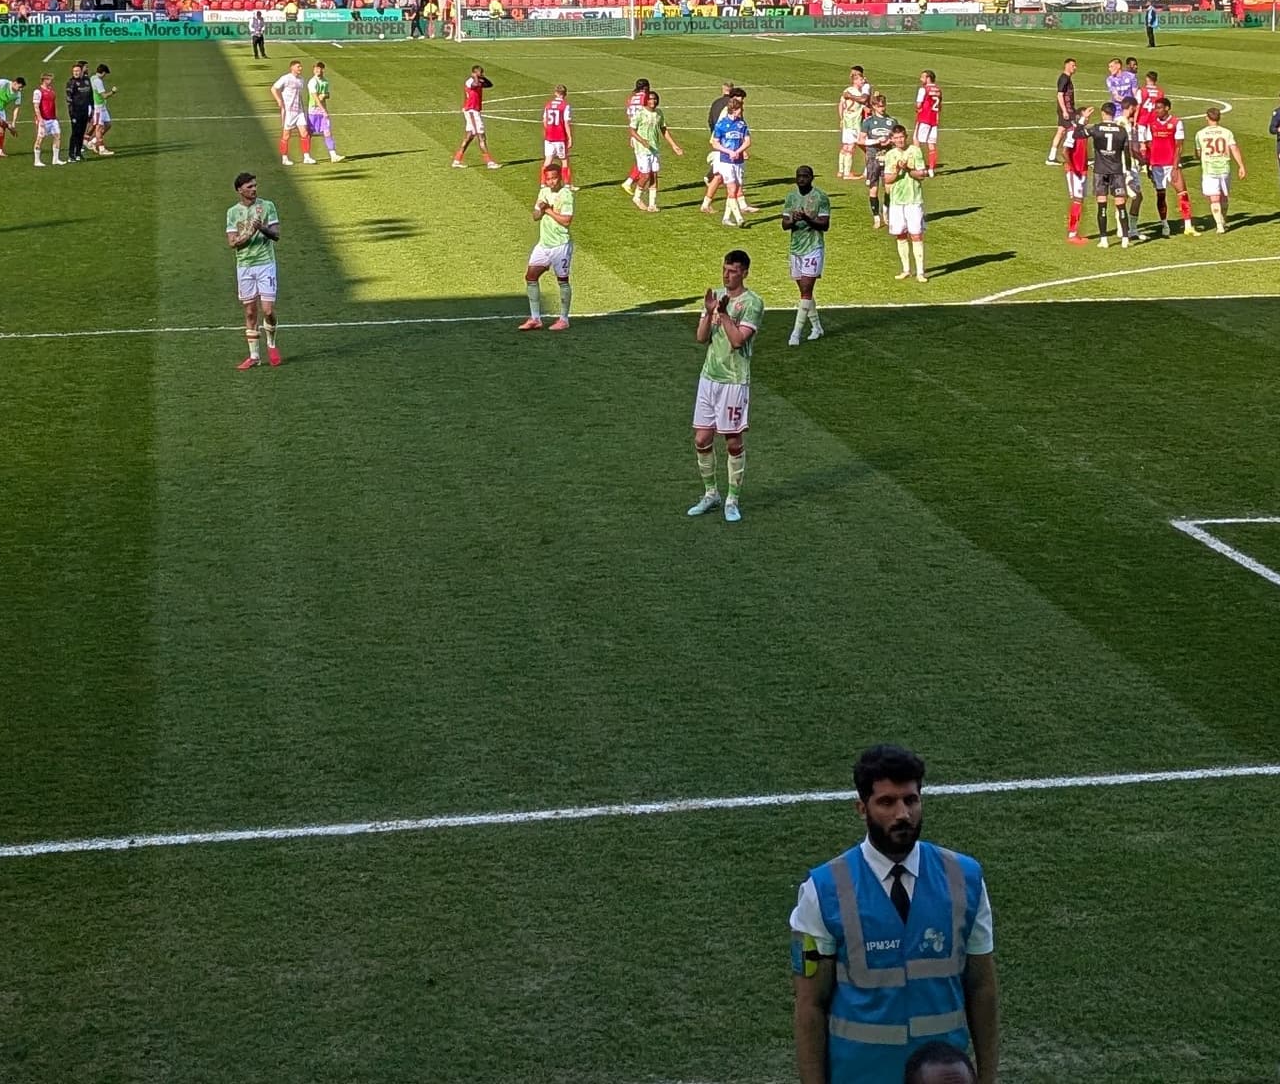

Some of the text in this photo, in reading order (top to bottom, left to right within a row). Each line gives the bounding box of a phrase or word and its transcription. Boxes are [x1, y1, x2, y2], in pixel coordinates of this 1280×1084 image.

[663, 18, 682, 30] for
[683, 20, 710, 33] you.
[713, 17, 759, 32] Capital
[813, 16, 868, 28] PROSPER
[956, 16, 1010, 27] PROSPER
[1081, 13, 1134, 26] PROSPER
[1179, 14, 1219, 25] fees...
[49, 24, 82, 37] Less
[84, 23, 96, 37] in
[98, 23, 142, 37] fees...
[144, 23, 181, 36] More
[182, 22, 203, 36] for
[203, 24, 234, 39] you.
[348, 22, 406, 35] PROSPER
[931, 97, 940, 112] 2
[547, 110, 560, 126] 51
[1105, 133, 1113, 151] 1
[1203, 138, 1227, 156] 30
[561, 259, 568, 269] 2
[804, 257, 818, 268] 24
[728, 406, 742, 422] 15
[866, 939, 901, 951] IPM347
